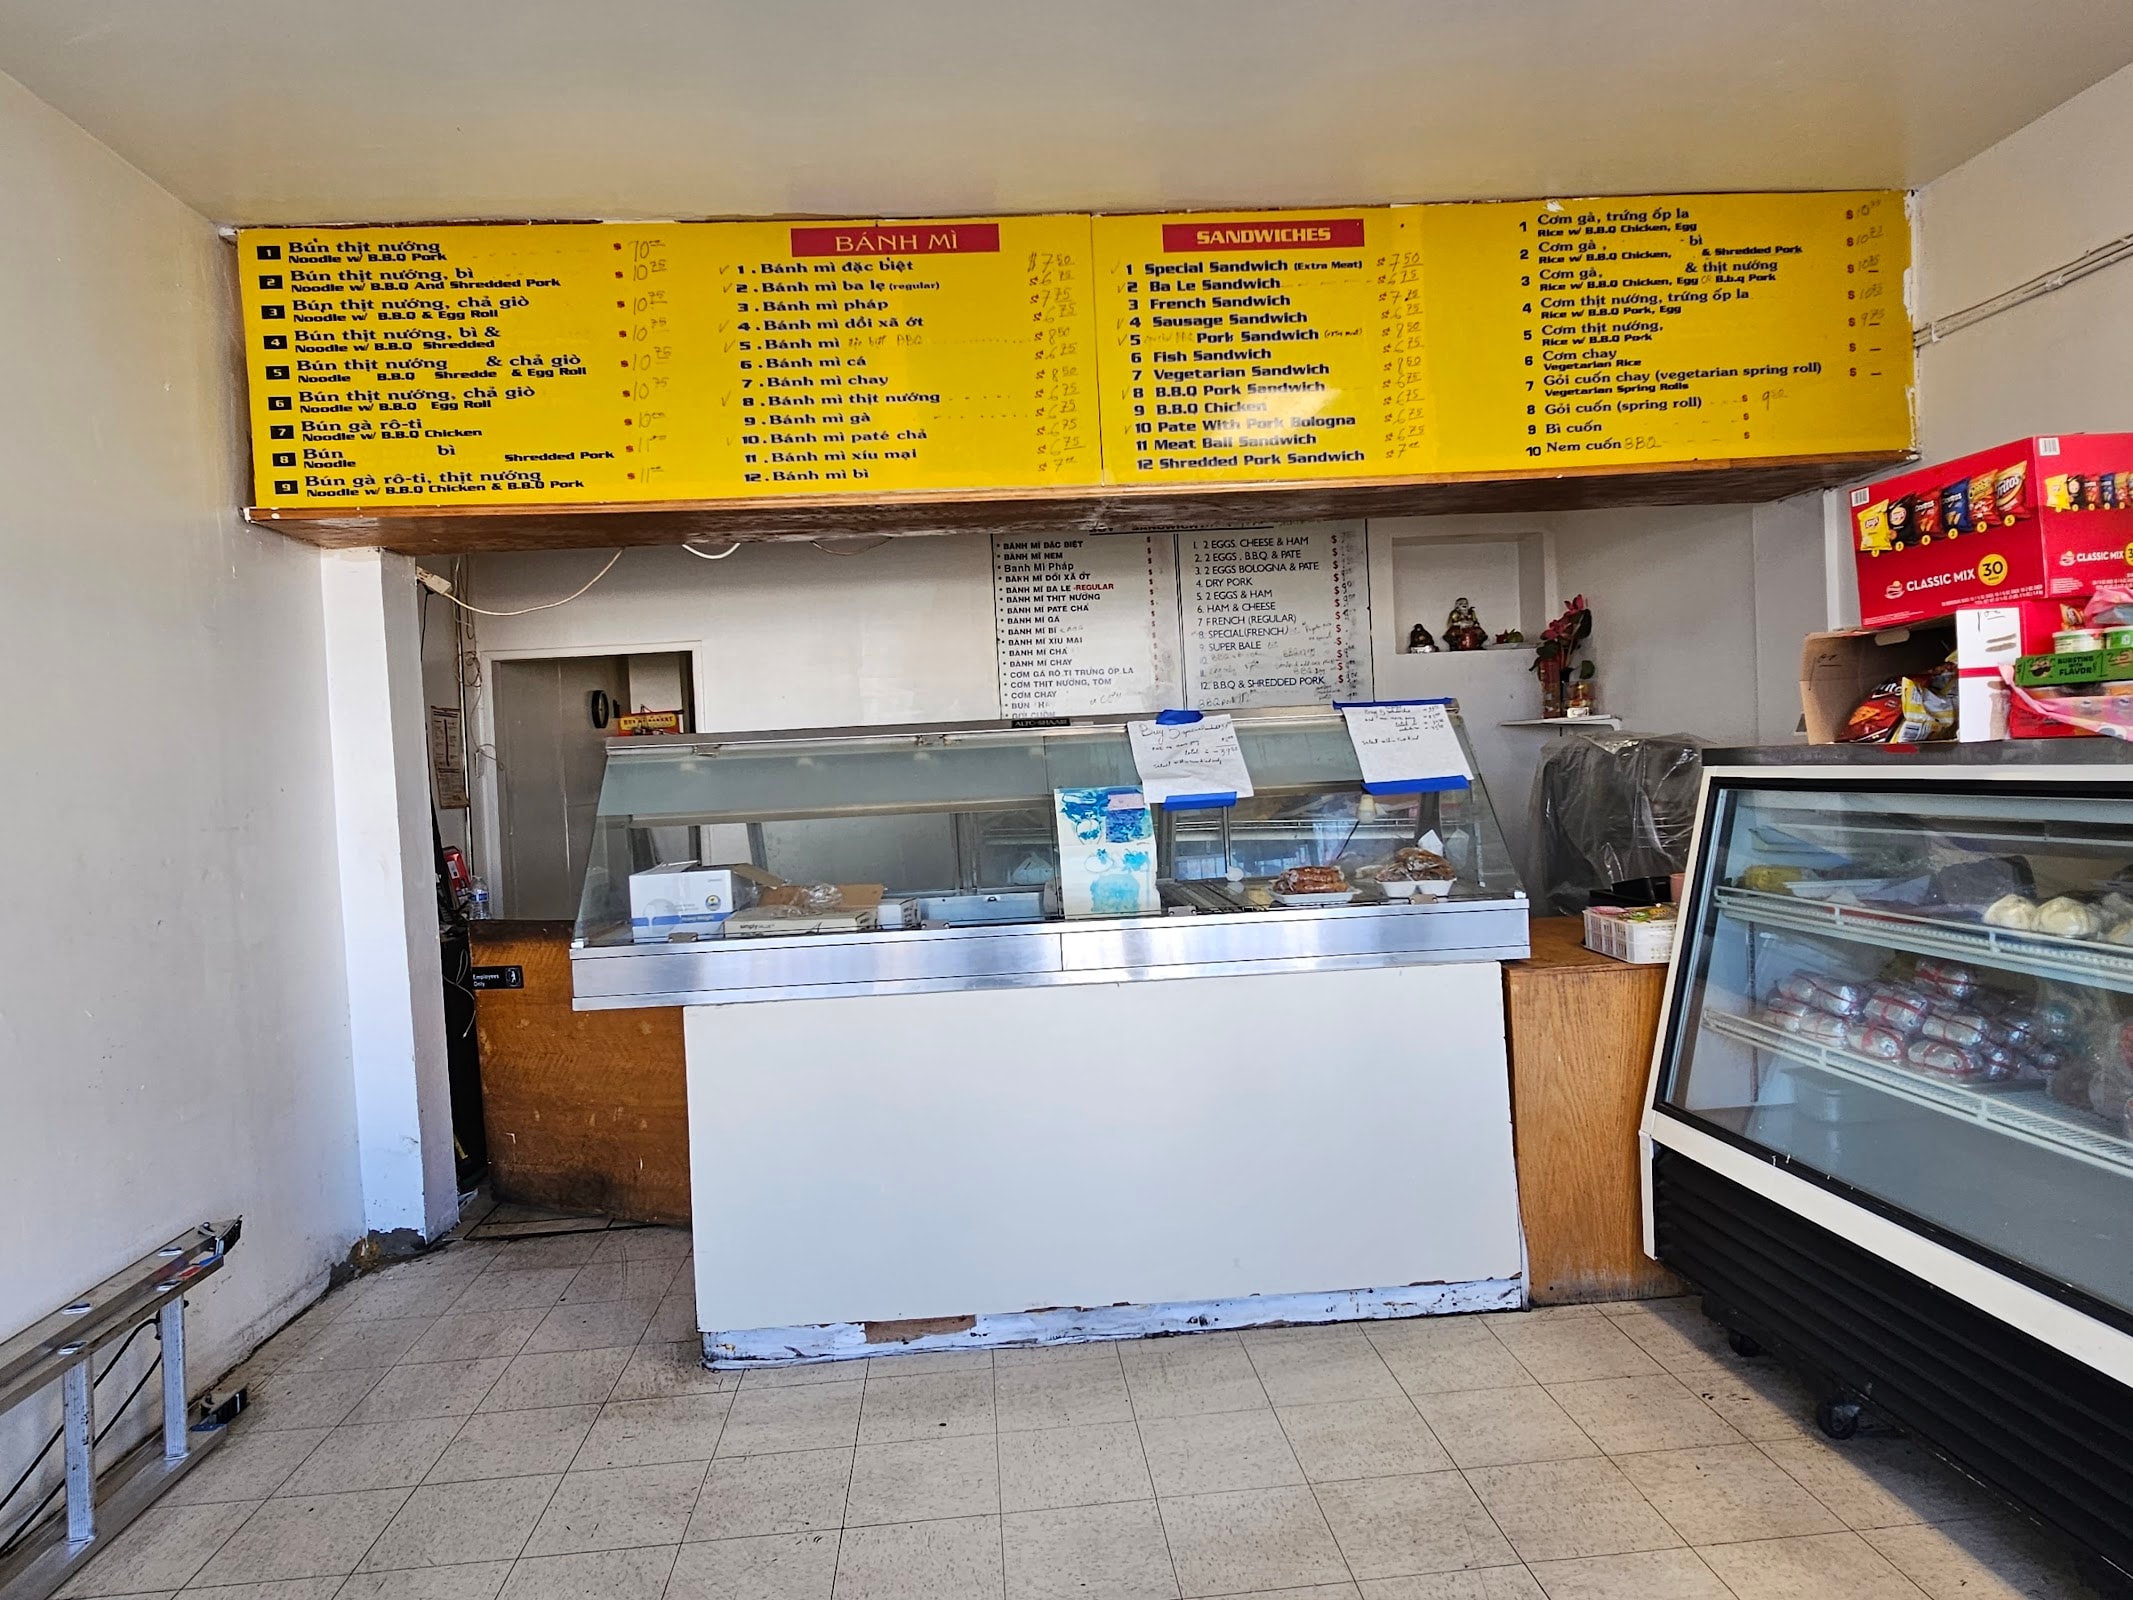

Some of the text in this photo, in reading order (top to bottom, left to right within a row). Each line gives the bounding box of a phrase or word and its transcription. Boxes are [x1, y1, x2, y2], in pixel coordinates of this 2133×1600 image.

[1538, 214, 1572, 225] Cơm
[1676, 208, 1689, 218] la
[1520, 222, 1526, 232] 1
[1568, 227, 1581, 235] w/
[1586, 226, 1616, 234] B.B.Q
[1621, 224, 1670, 232] Chicken,
[1675, 223, 1697, 232] Egg
[836, 232, 957, 251] BÁNH MÌ
[1197, 228, 1330, 244] SANDWICHES
[336, 242, 370, 255] thịt
[289, 255, 341, 263] Noodle
[412, 252, 447, 261] Pork
[761, 263, 807, 273] Bánh
[814, 262, 835, 272] mì
[1127, 260, 1362, 276] 1 Special Sandwich (Extra Meat)
[290, 270, 331, 281] Bún
[338, 270, 372, 282] thịt
[456, 268, 473, 278] bì
[292, 284, 344, 292] Noodle
[350, 283, 365, 291] w/
[414, 282, 444, 290] And
[450, 280, 521, 288] Shredded
[526, 278, 560, 287] Pork
[762, 282, 808, 292] Bánh
[815, 281, 836, 291] mì
[843, 281, 863, 290] ba
[889, 282, 939, 291] (regular)
[1128, 278, 1280, 292] 2 Ba Le Sandwich
[1129, 295, 1290, 310] 3 French Sandwich
[1130, 312, 1307, 328] 4 Sausage Sandwich
[1524, 330, 1532, 340] 5
[1542, 325, 1576, 335] Cơm
[1582, 323, 1606, 334] thịt
[1590, 335, 1620, 344] B.B.Q
[1624, 334, 1652, 342] Pork
[1132, 348, 1271, 363] 6 Fish Sandwich
[1543, 348, 1617, 361] Cơm chay
[297, 354, 580, 372] Bún thịt nướng & chả giò
[766, 358, 812, 368] Bánh
[820, 357, 840, 366] mì
[847, 356, 866, 366] cá
[1525, 356, 1533, 366] 6
[1544, 361, 1611, 371] Vegetarian
[298, 374, 351, 383] Noodle
[377, 372, 415, 380] B.B.Q
[435, 370, 497, 379] Shredde
[528, 369, 554, 378] Egg
[560, 367, 586, 375] Roll
[1132, 364, 1329, 382] 7 Vegetarian Sandwich
[1575, 371, 1610, 384] cuốn
[1616, 372, 1650, 383] chay
[1656, 368, 1738, 382] (vegetarian
[1744, 365, 1788, 377] spring
[1794, 362, 1821, 374] roll)
[768, 376, 813, 386] Bánh
[820, 376, 841, 385] mì
[848, 375, 888, 384] chay
[1526, 381, 1533, 391] 7
[1545, 387, 1612, 397] Vegetarian
[1617, 384, 1656, 394] Spring
[768, 395, 814, 406] Bánh
[822, 394, 842, 404] mì
[849, 394, 878, 404] thịt
[301, 419, 422, 433] Bún gà rô-ti
[303, 433, 355, 441] Noodle
[382, 431, 419, 439] B.B.Q
[425, 429, 482, 437] Chicken
[1138, 451, 1364, 469] 12 Shredded Pork Sandwich
[2076, 551, 2124, 562] CLASSIC MIX
[1906, 561, 2003, 591] CLASSIC MIX 30
[1206, 579, 1224, 588] DRY
[1227, 577, 1253, 586] PORK
[1206, 592, 1211, 600] 2
[1214, 591, 1238, 600] EGGS
[1250, 590, 1272, 598] HAM
[1207, 604, 1229, 612] HAM
[1242, 602, 1275, 611] CHEESE
[2058, 656, 2094, 664] BURSTING
[2059, 666, 2092, 676] FLAVOR
